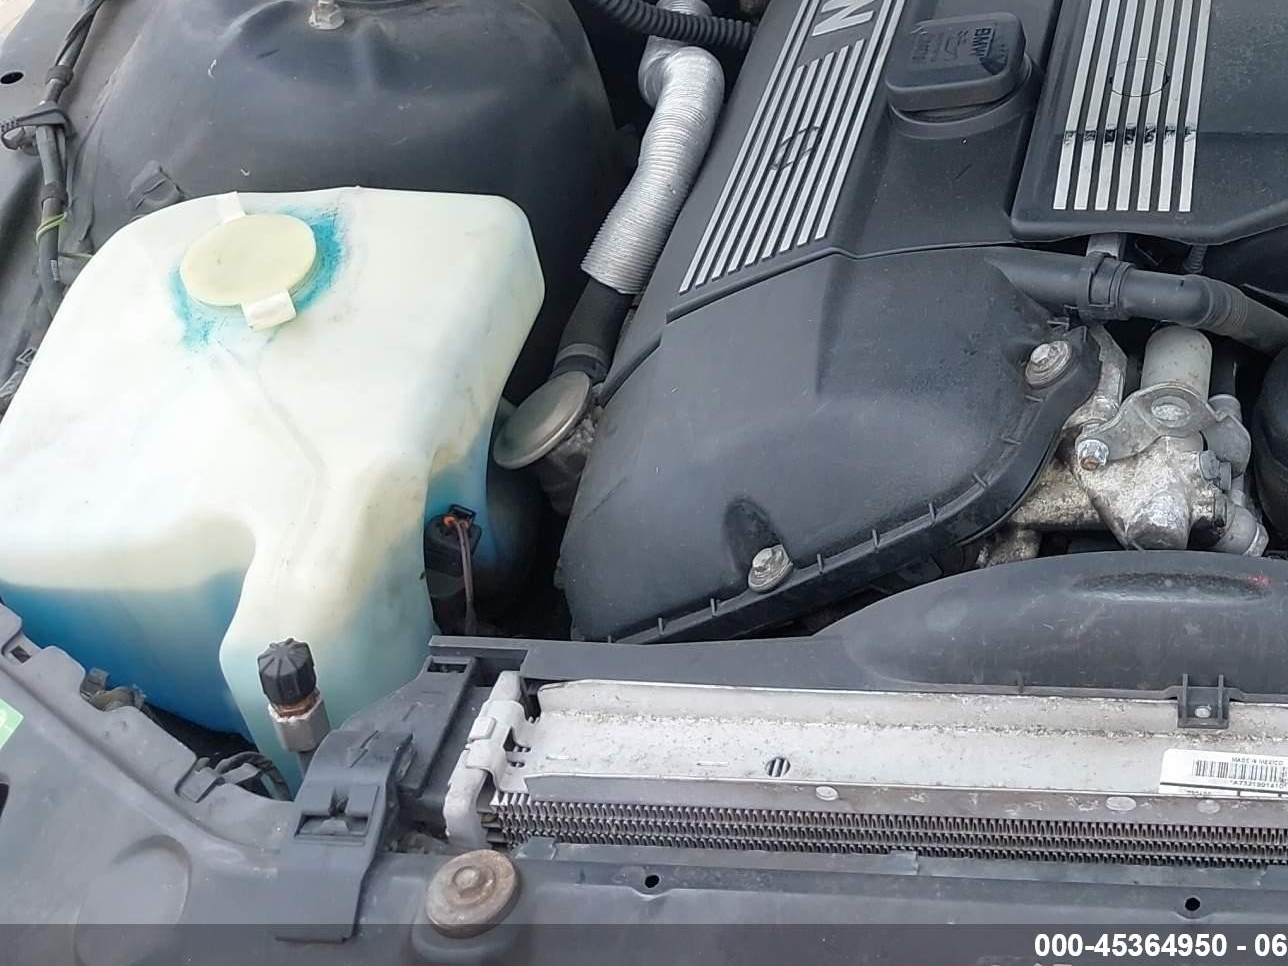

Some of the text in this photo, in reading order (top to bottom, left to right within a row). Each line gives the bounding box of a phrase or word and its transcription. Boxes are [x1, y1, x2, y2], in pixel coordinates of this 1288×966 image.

[969, 27, 992, 57] BMW
[1231, 756, 1250, 765] MADE
[1259, 758, 1284, 766] MEXICO
